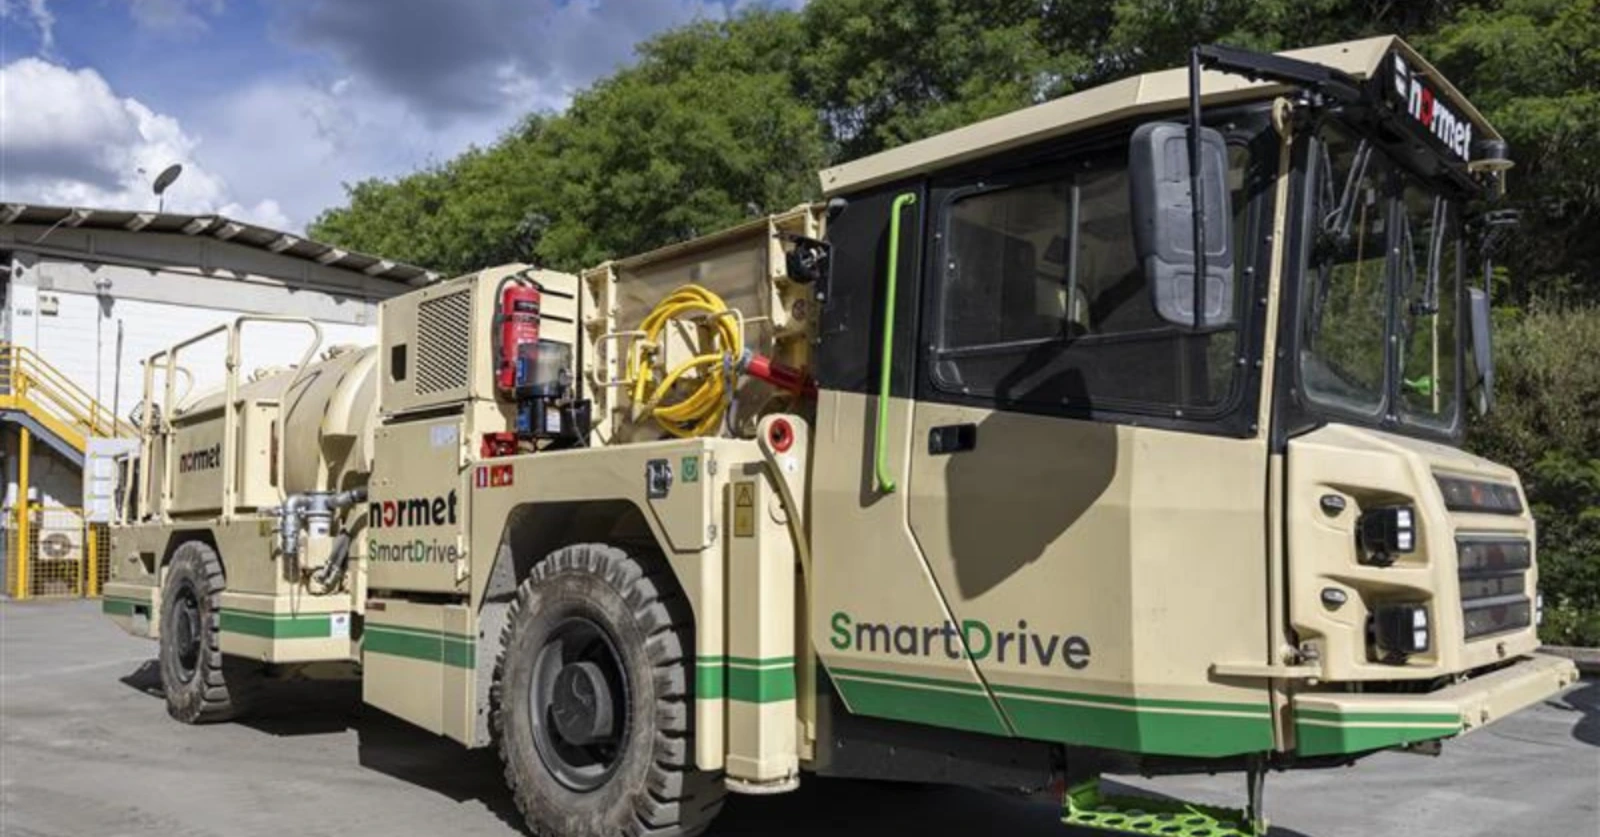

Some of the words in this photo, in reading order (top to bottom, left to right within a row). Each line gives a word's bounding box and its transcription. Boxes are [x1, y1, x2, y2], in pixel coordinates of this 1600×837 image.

[1408, 78, 1472, 163] normet
[179, 442, 221, 473] normet
[369, 488, 457, 528] normet
[368, 538, 457, 563] SmartDrive
[830, 611, 1091, 670] SmartDrive
